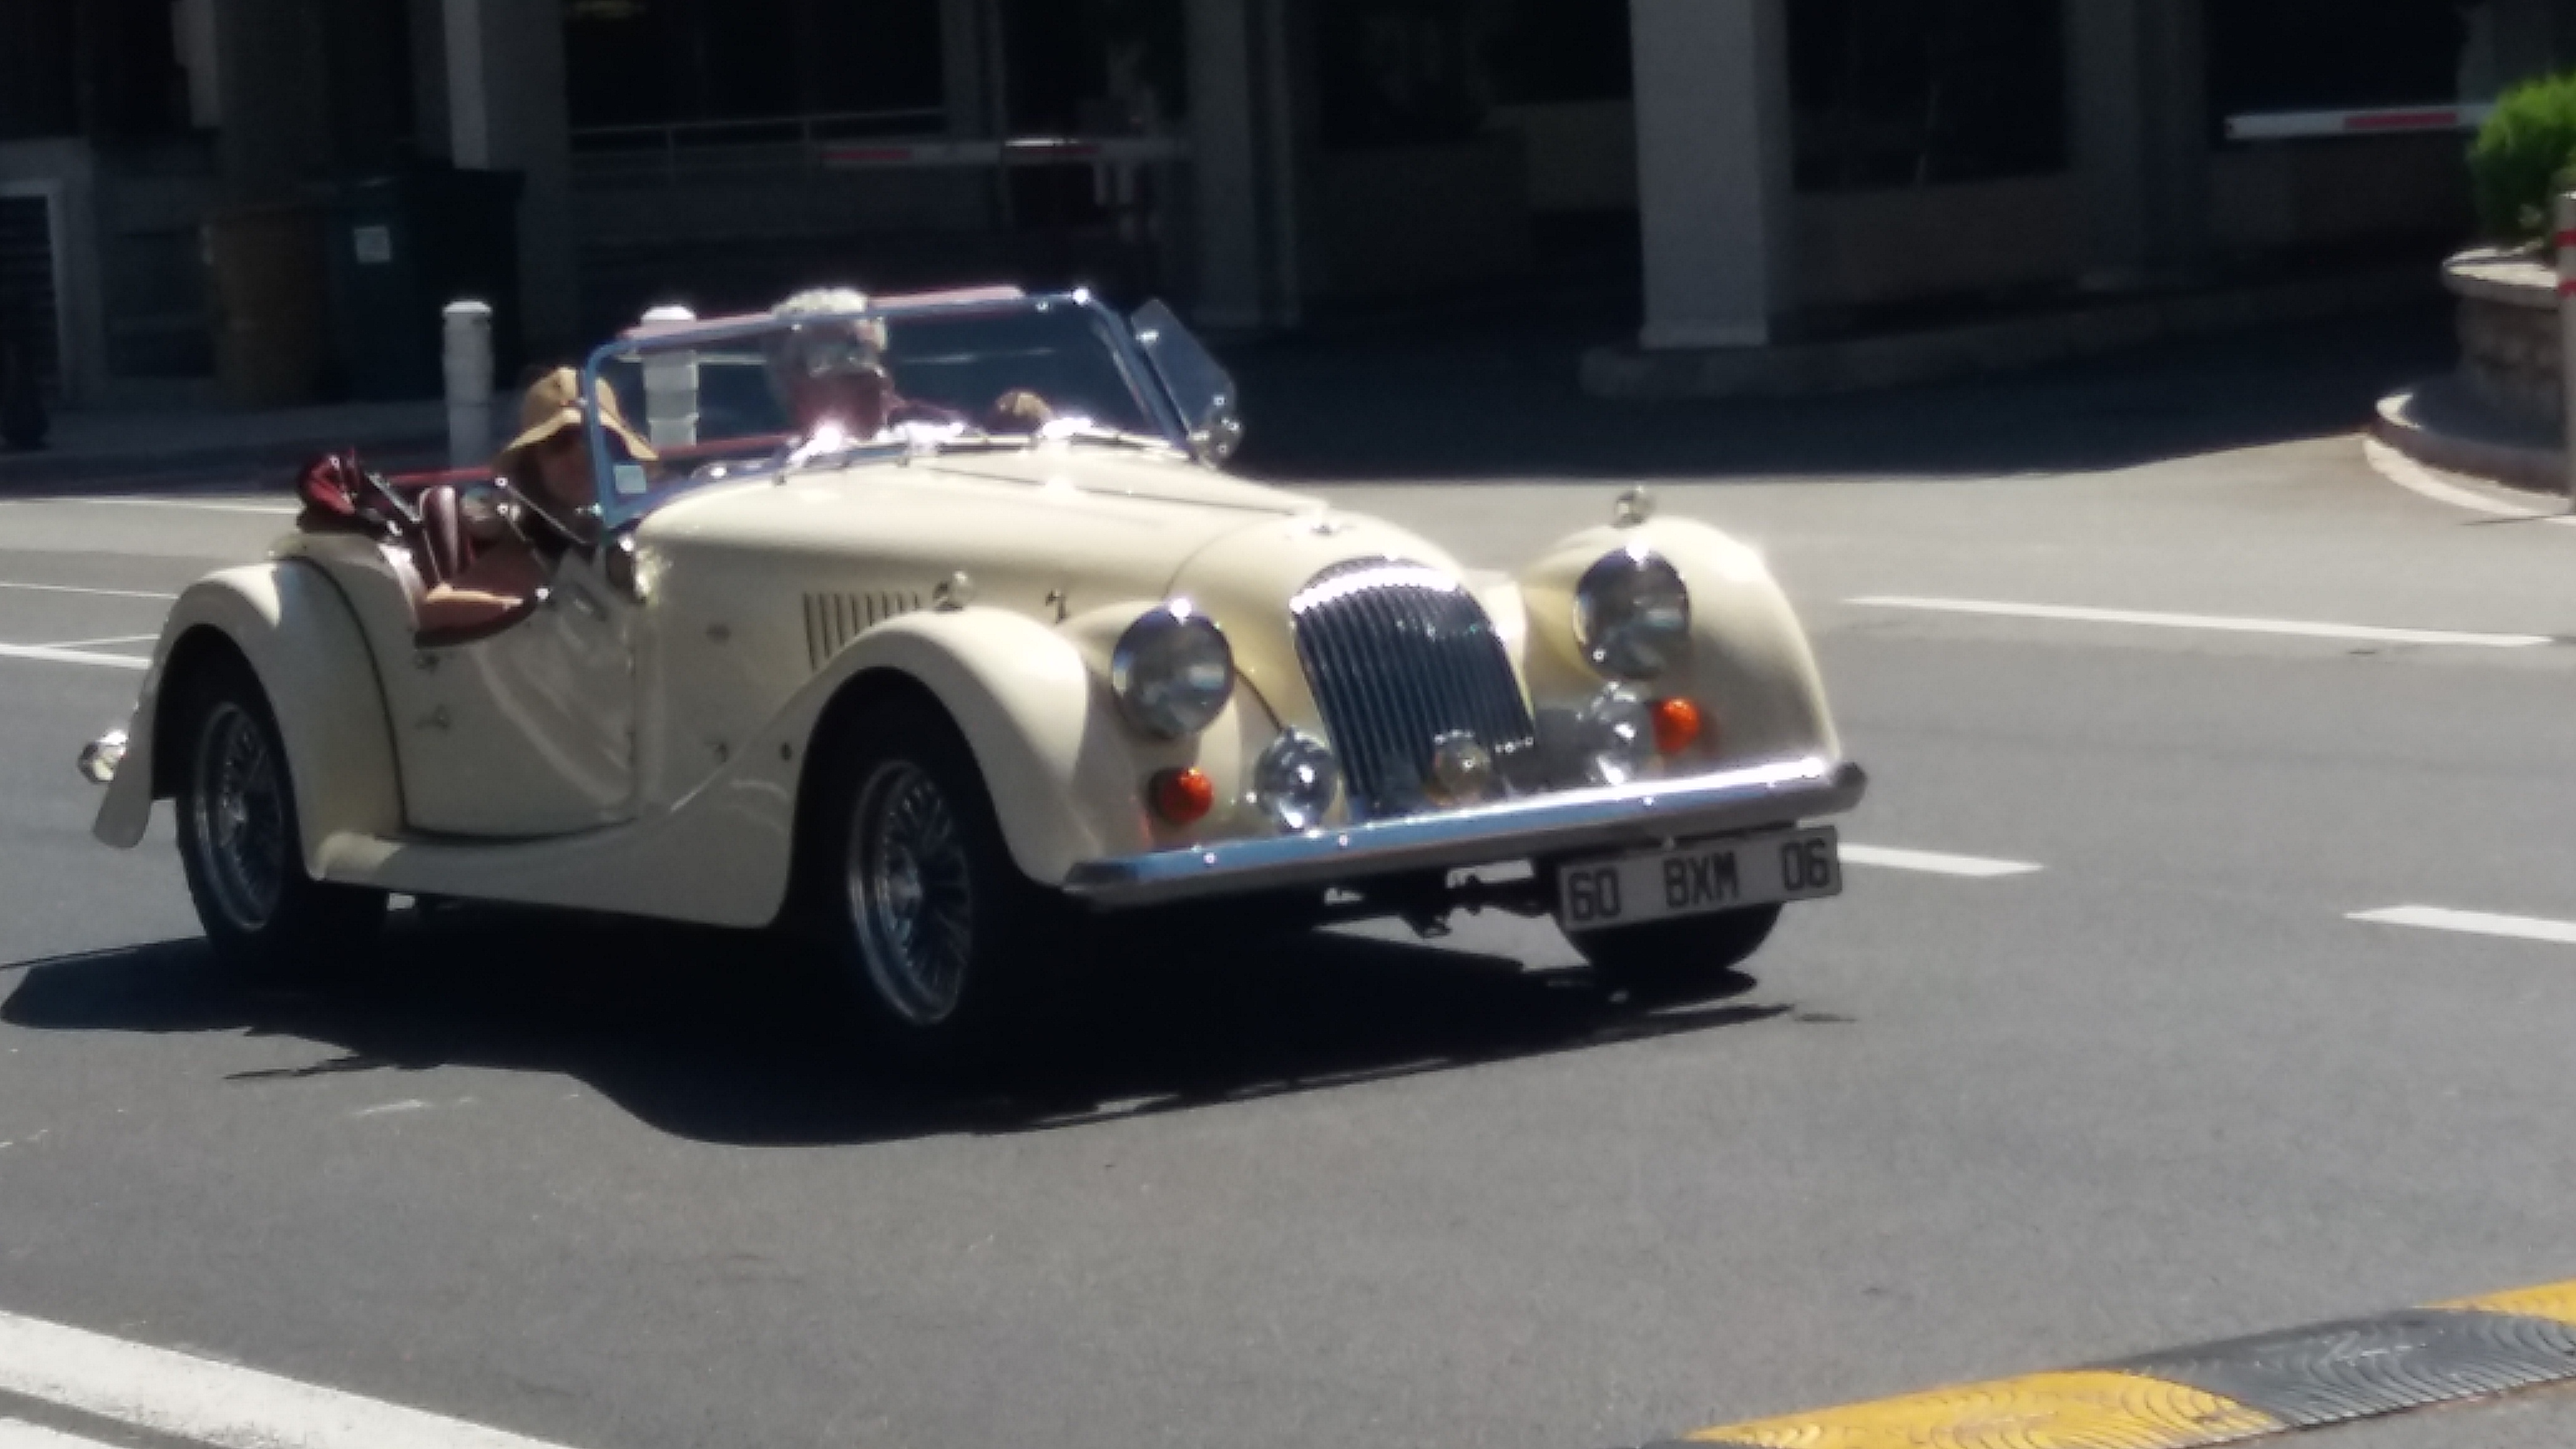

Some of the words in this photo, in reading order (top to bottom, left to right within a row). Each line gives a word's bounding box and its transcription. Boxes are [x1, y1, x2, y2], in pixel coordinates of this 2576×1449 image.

[1568, 867, 1621, 920] 60
[1663, 851, 1741, 909] BXM
[1781, 838, 1831, 892] 06
